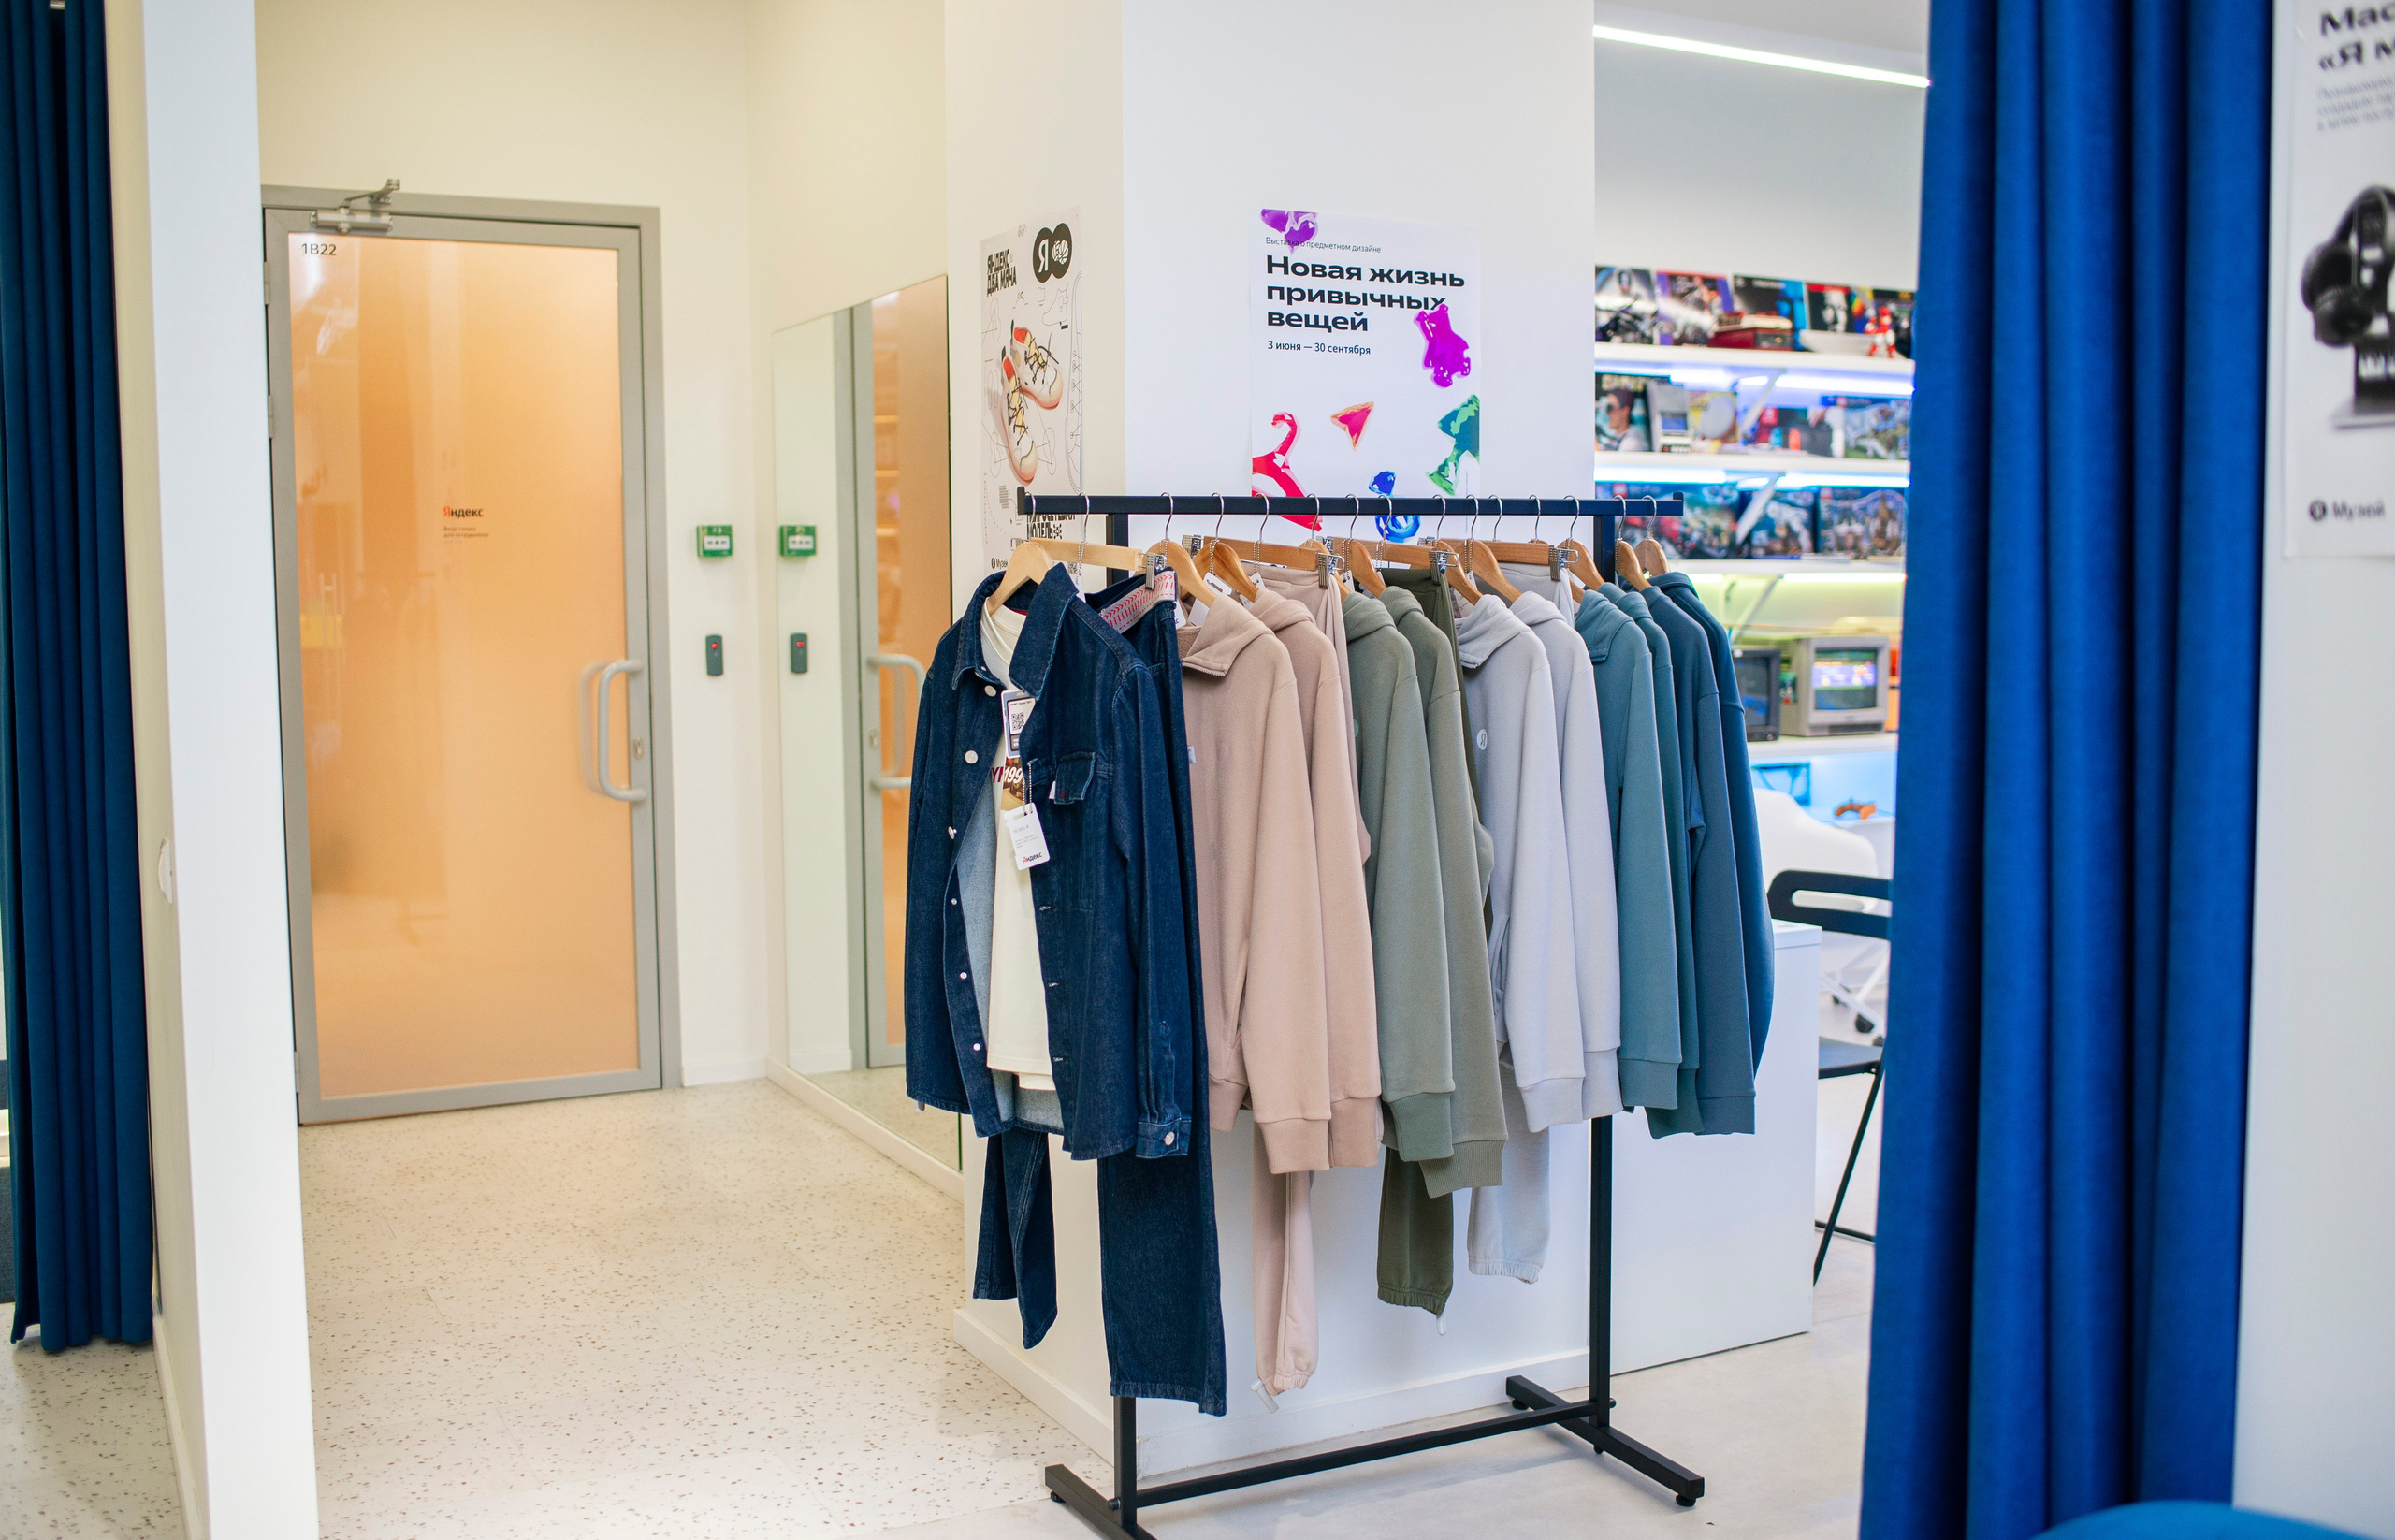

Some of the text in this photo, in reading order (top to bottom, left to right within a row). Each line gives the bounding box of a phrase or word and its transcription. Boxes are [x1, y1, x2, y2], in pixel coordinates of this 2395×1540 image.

[301, 242, 337, 256] 1B22
[1266, 237, 1299, 247] Выставка
[1306, 241, 1351, 251] предметном
[1351, 244, 1382, 254] дизайне
[1267, 254, 1465, 287] Новая жизнь
[1267, 285, 1446, 311] привычных
[1267, 311, 1369, 333] вещей
[1268, 340, 1274, 350] 3
[1275, 341, 1301, 352] июня
[1314, 342, 1326, 353] 30
[1327, 344, 1372, 356] сентября
[443, 505, 484, 518] Яндекс
[1022, 852, 1043, 864] Яндекс
